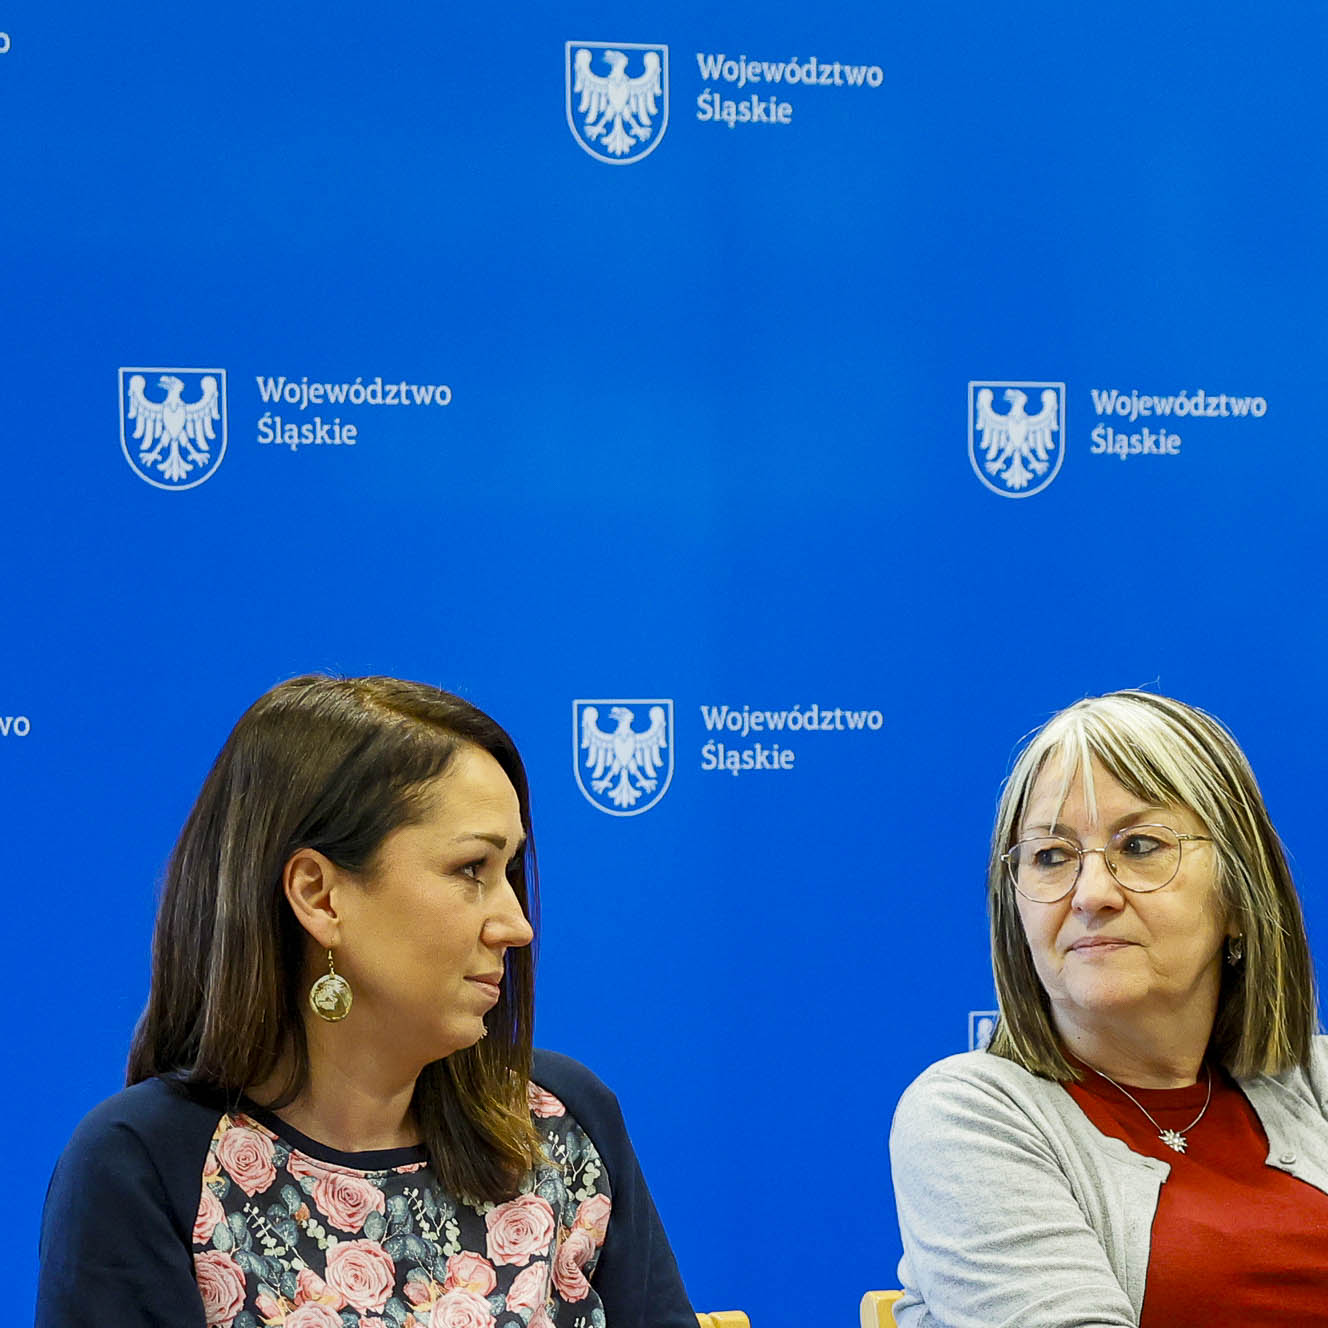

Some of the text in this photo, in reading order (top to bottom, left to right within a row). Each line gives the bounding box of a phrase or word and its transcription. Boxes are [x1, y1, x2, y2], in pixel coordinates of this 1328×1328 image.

[697, 52, 884, 88] Województwo
[697, 88, 793, 127] Śląskie
[257, 375, 452, 411] Województwo
[1091, 388, 1268, 422] Województwo
[258, 411, 358, 451] Śląskie
[1091, 423, 1182, 459] Śląskie
[701, 703, 884, 736] Województwo
[702, 739, 795, 774] Śląskie
